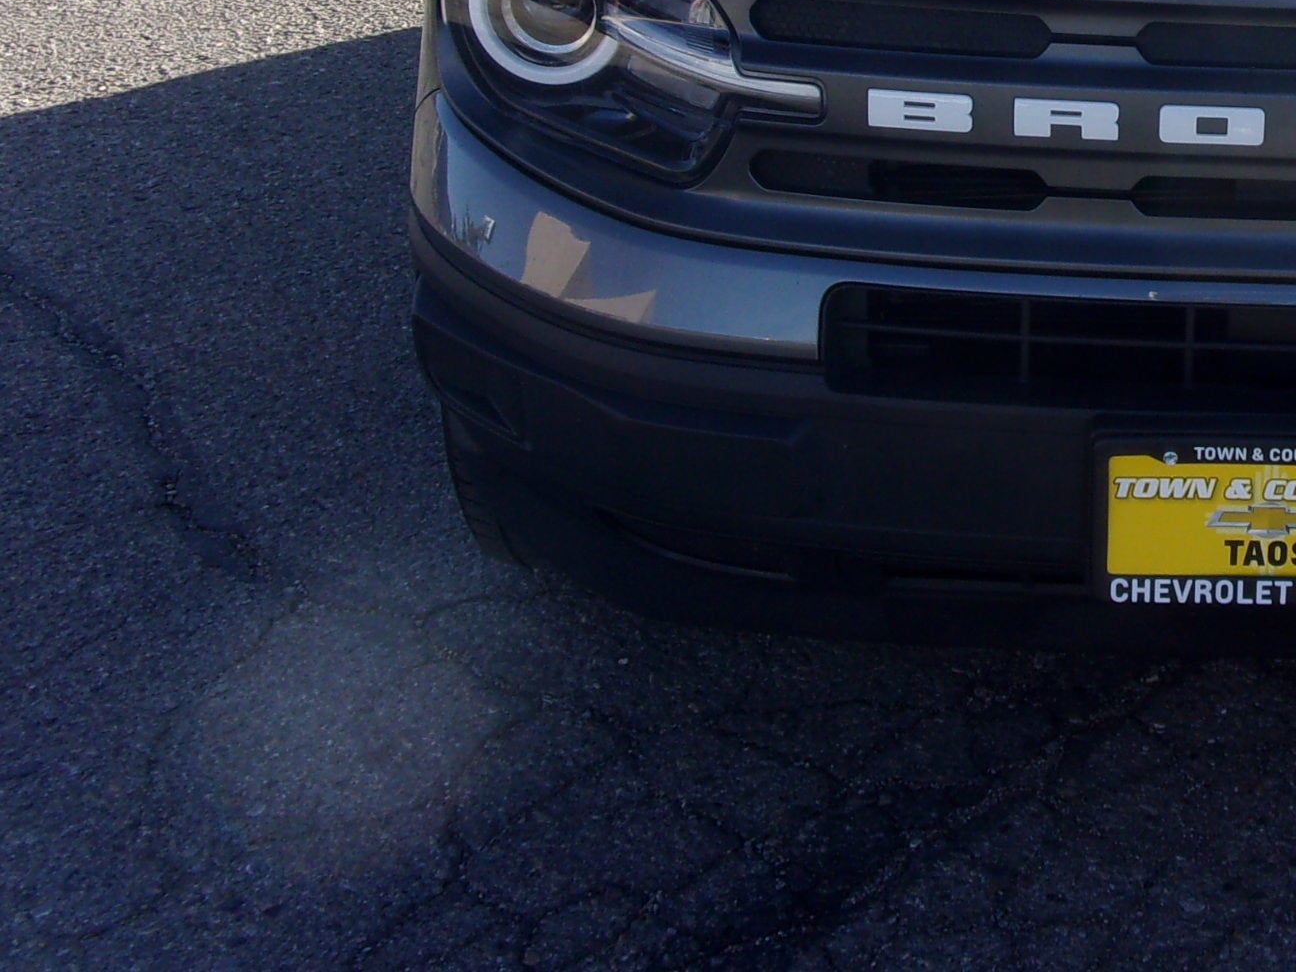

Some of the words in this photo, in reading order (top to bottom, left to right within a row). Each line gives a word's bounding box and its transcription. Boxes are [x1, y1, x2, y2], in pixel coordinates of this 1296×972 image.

[1194, 446, 1250, 461] TOWN
[1252, 448, 1264, 461] &
[1113, 477, 1216, 500] TOWN
[1225, 478, 1252, 500] &
[1110, 578, 1292, 605] CHEVROLET
